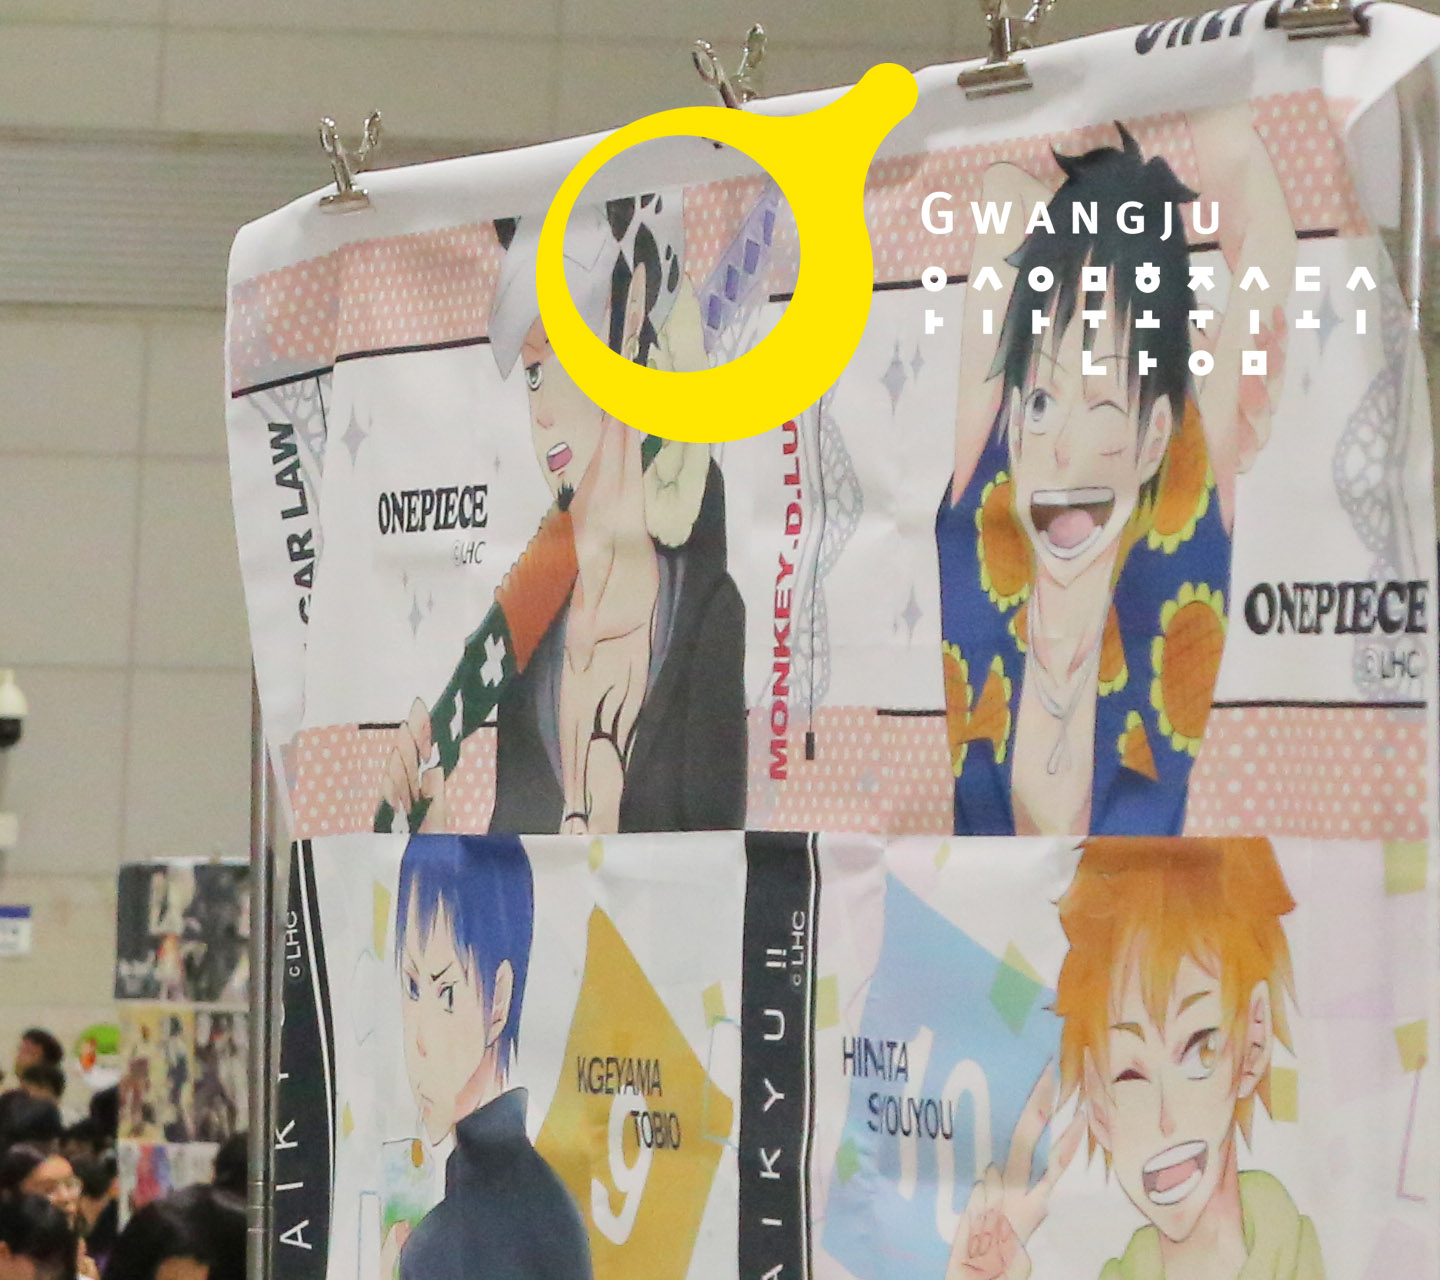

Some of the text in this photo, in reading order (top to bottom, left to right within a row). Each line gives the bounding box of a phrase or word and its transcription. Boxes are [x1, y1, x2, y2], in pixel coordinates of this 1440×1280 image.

[268, 422, 309, 520] LAW
[378, 484, 489, 535] ONEPIECE
[769, 420, 802, 781] MONKEY.D.LU
[1244, 580, 1430, 636] ONEPIECE
[630, 1109, 681, 1150] TOBIO
